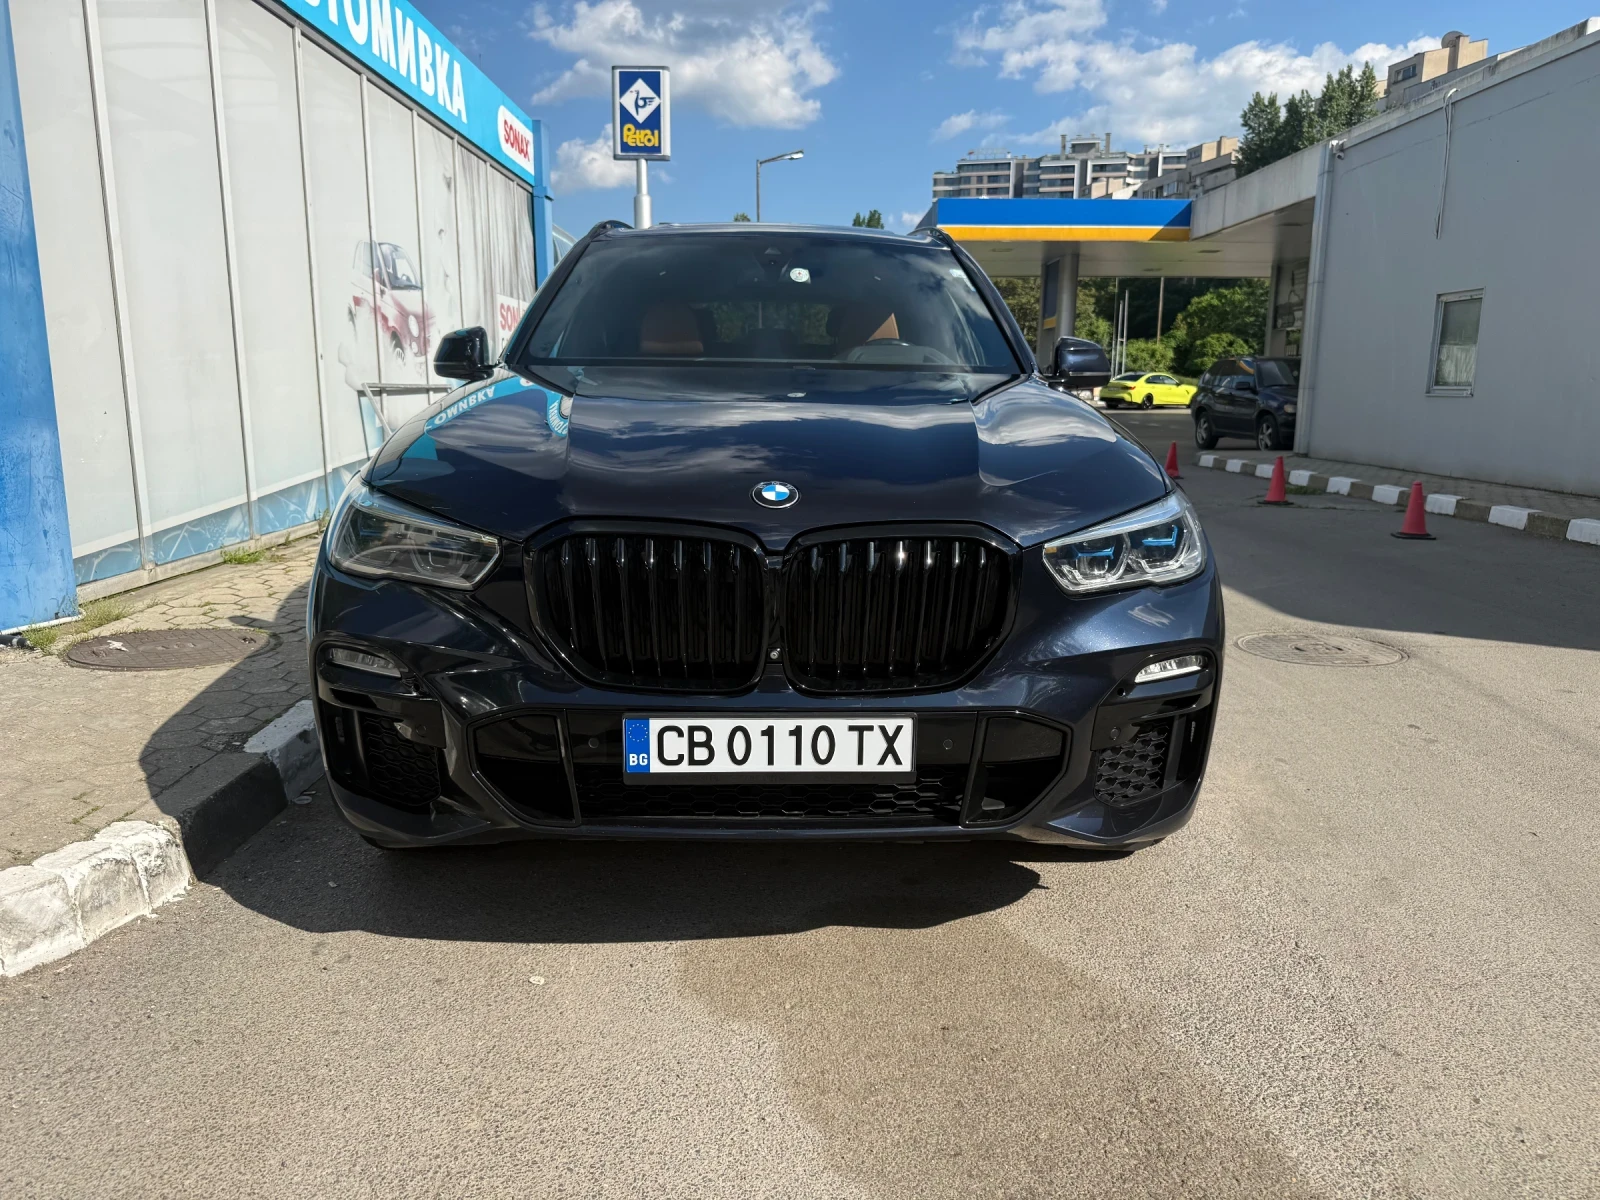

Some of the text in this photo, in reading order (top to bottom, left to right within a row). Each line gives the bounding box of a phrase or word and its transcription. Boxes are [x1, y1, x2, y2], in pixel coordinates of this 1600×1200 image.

[304, 0, 467, 124] ОМИВКА
[504, 119, 530, 162] SONAX
[623, 124, 659, 147] Petrol
[500, 303, 526, 332] SON
[629, 754, 648, 766] BG
[657, 725, 904, 766] CB 0110 TX
